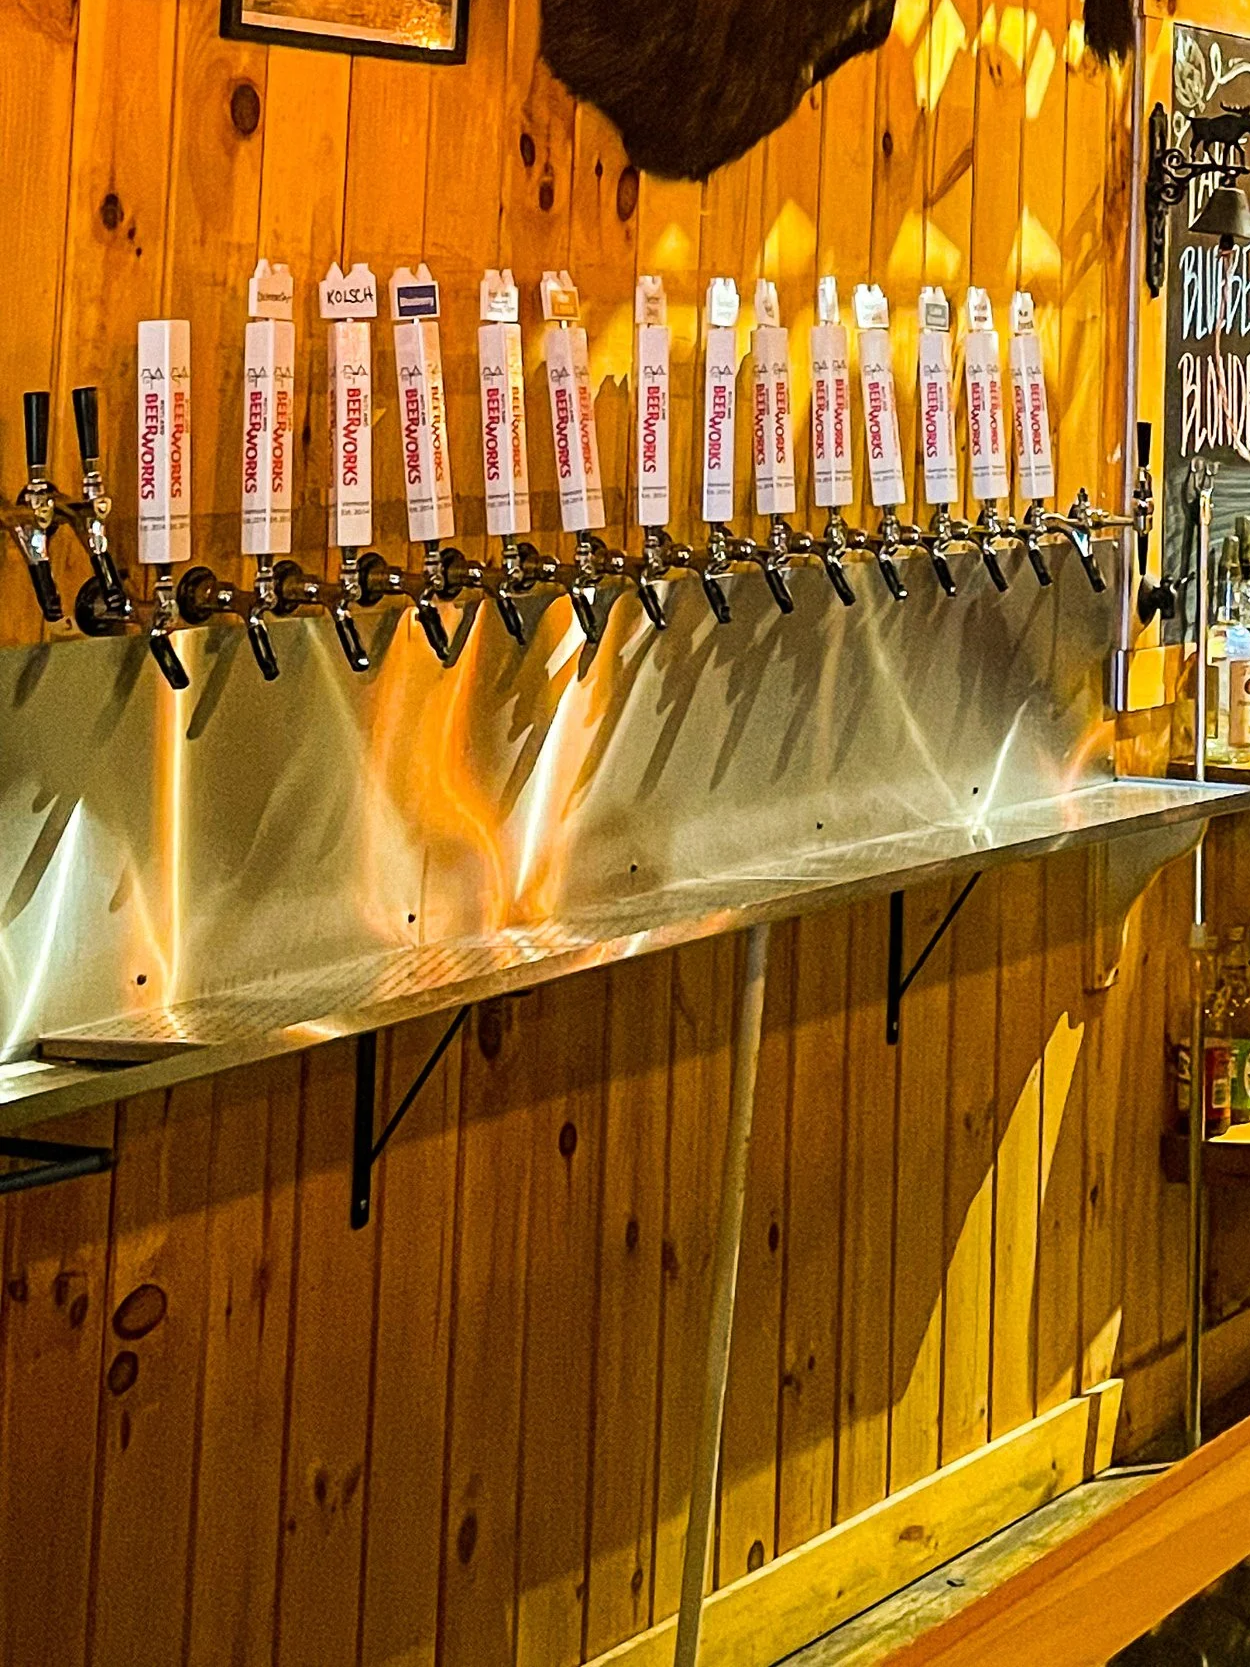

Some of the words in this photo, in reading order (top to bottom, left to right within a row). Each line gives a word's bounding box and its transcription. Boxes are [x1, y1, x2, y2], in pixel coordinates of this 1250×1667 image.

[327, 286, 374, 305] KOLSCH
[141, 393, 159, 500] BEERWORKS
[170, 392, 186, 498] BEERWORKS
[245, 391, 262, 494] BEERWORKS
[272, 391, 288, 493] BEERWORKS
[343, 388, 361, 486] BEERWORKS
[405, 388, 421, 485] BEERWORKS
[486, 387, 500, 481] BEERWORKS
[555, 388, 571, 479] BEERWORKS
[643, 386, 660, 473] BEERWORKS
[708, 385, 726, 470] BEERWORKS
[755, 384, 766, 465] BEERWORKS
[774, 382, 786, 463] BEERWORKS
[815, 380, 825, 459] BEERWORKS
[834, 379, 844, 458] BEERWORKS
[868, 382, 883, 459] BEERWORKS
[926, 382, 938, 458] BEERWORKS
[971, 382, 982, 456] BEERWORKS
[1030, 383, 1043, 455] BEERWORKS
